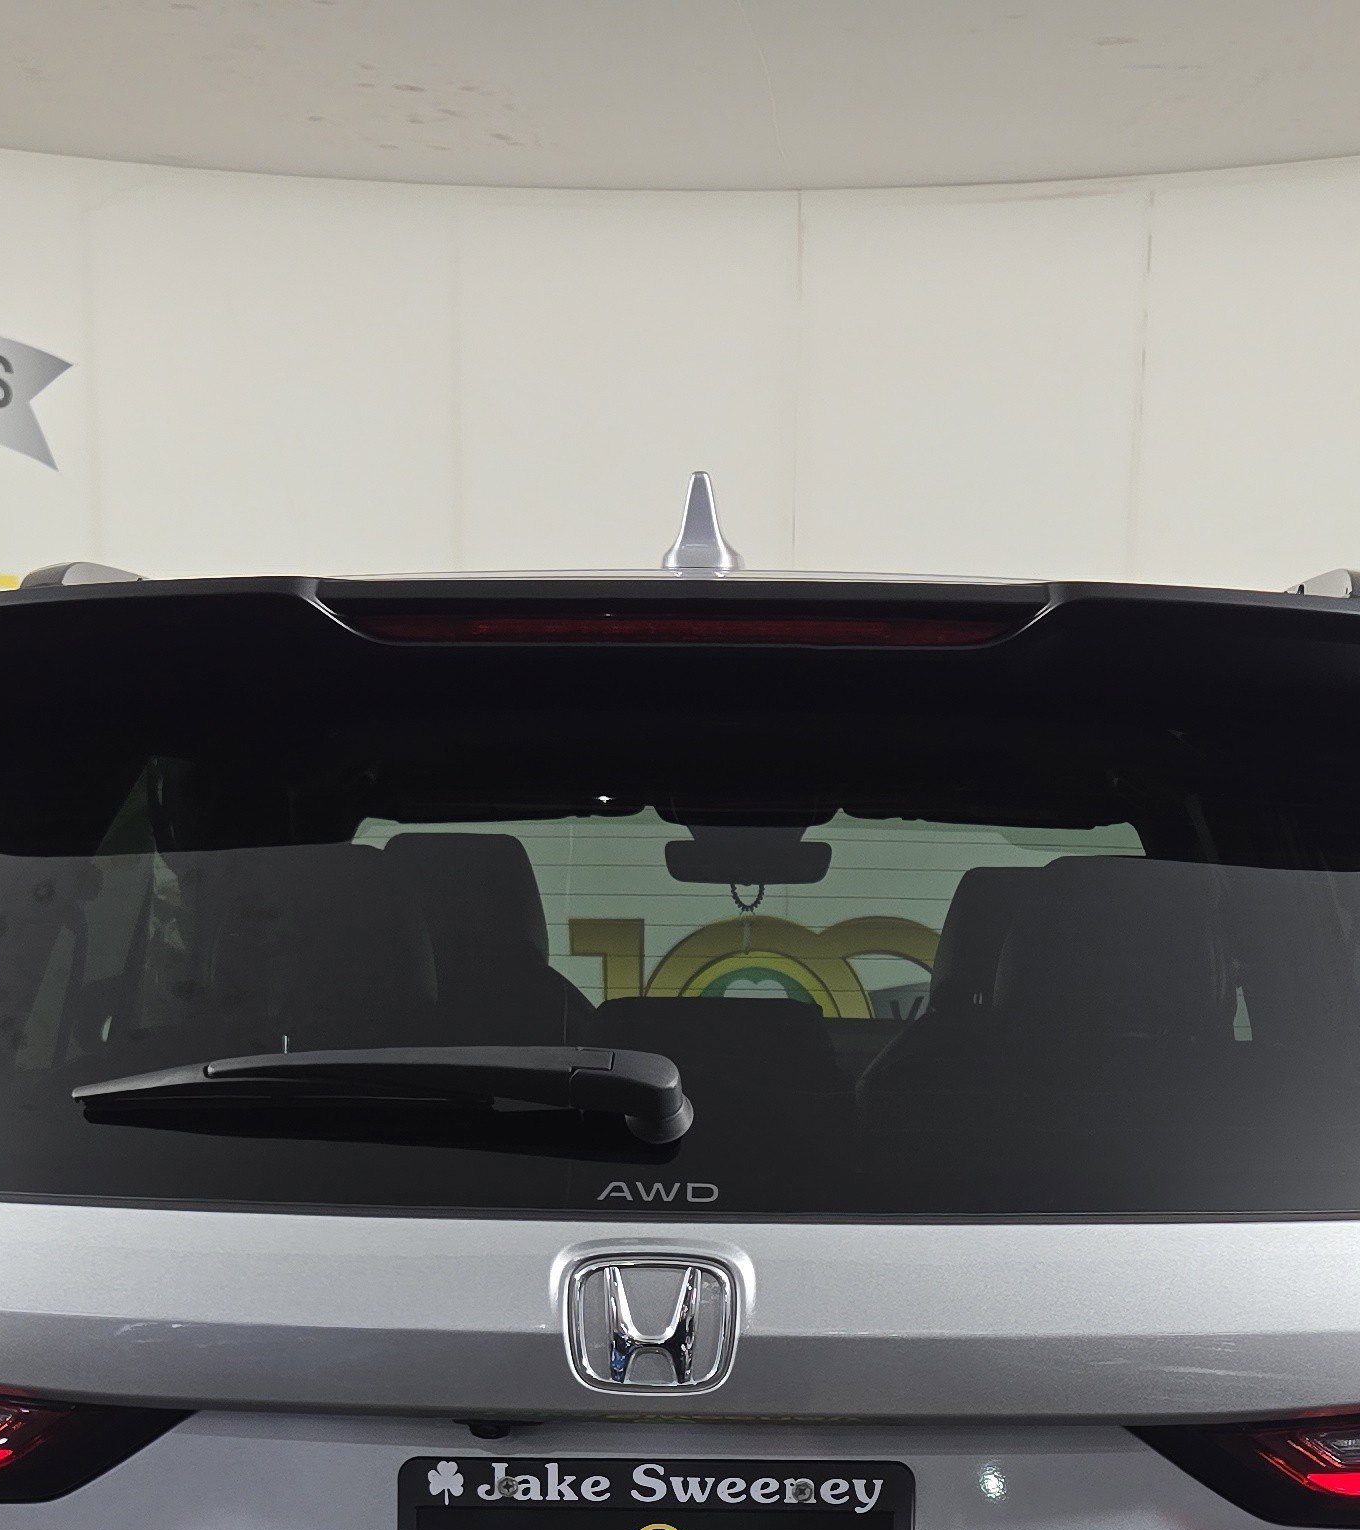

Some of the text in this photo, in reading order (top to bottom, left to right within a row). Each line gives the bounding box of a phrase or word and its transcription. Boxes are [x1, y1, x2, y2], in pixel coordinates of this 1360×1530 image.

[597, 1181, 720, 1203] AWD
[477, 1463, 884, 1514] Jake Sweeney
